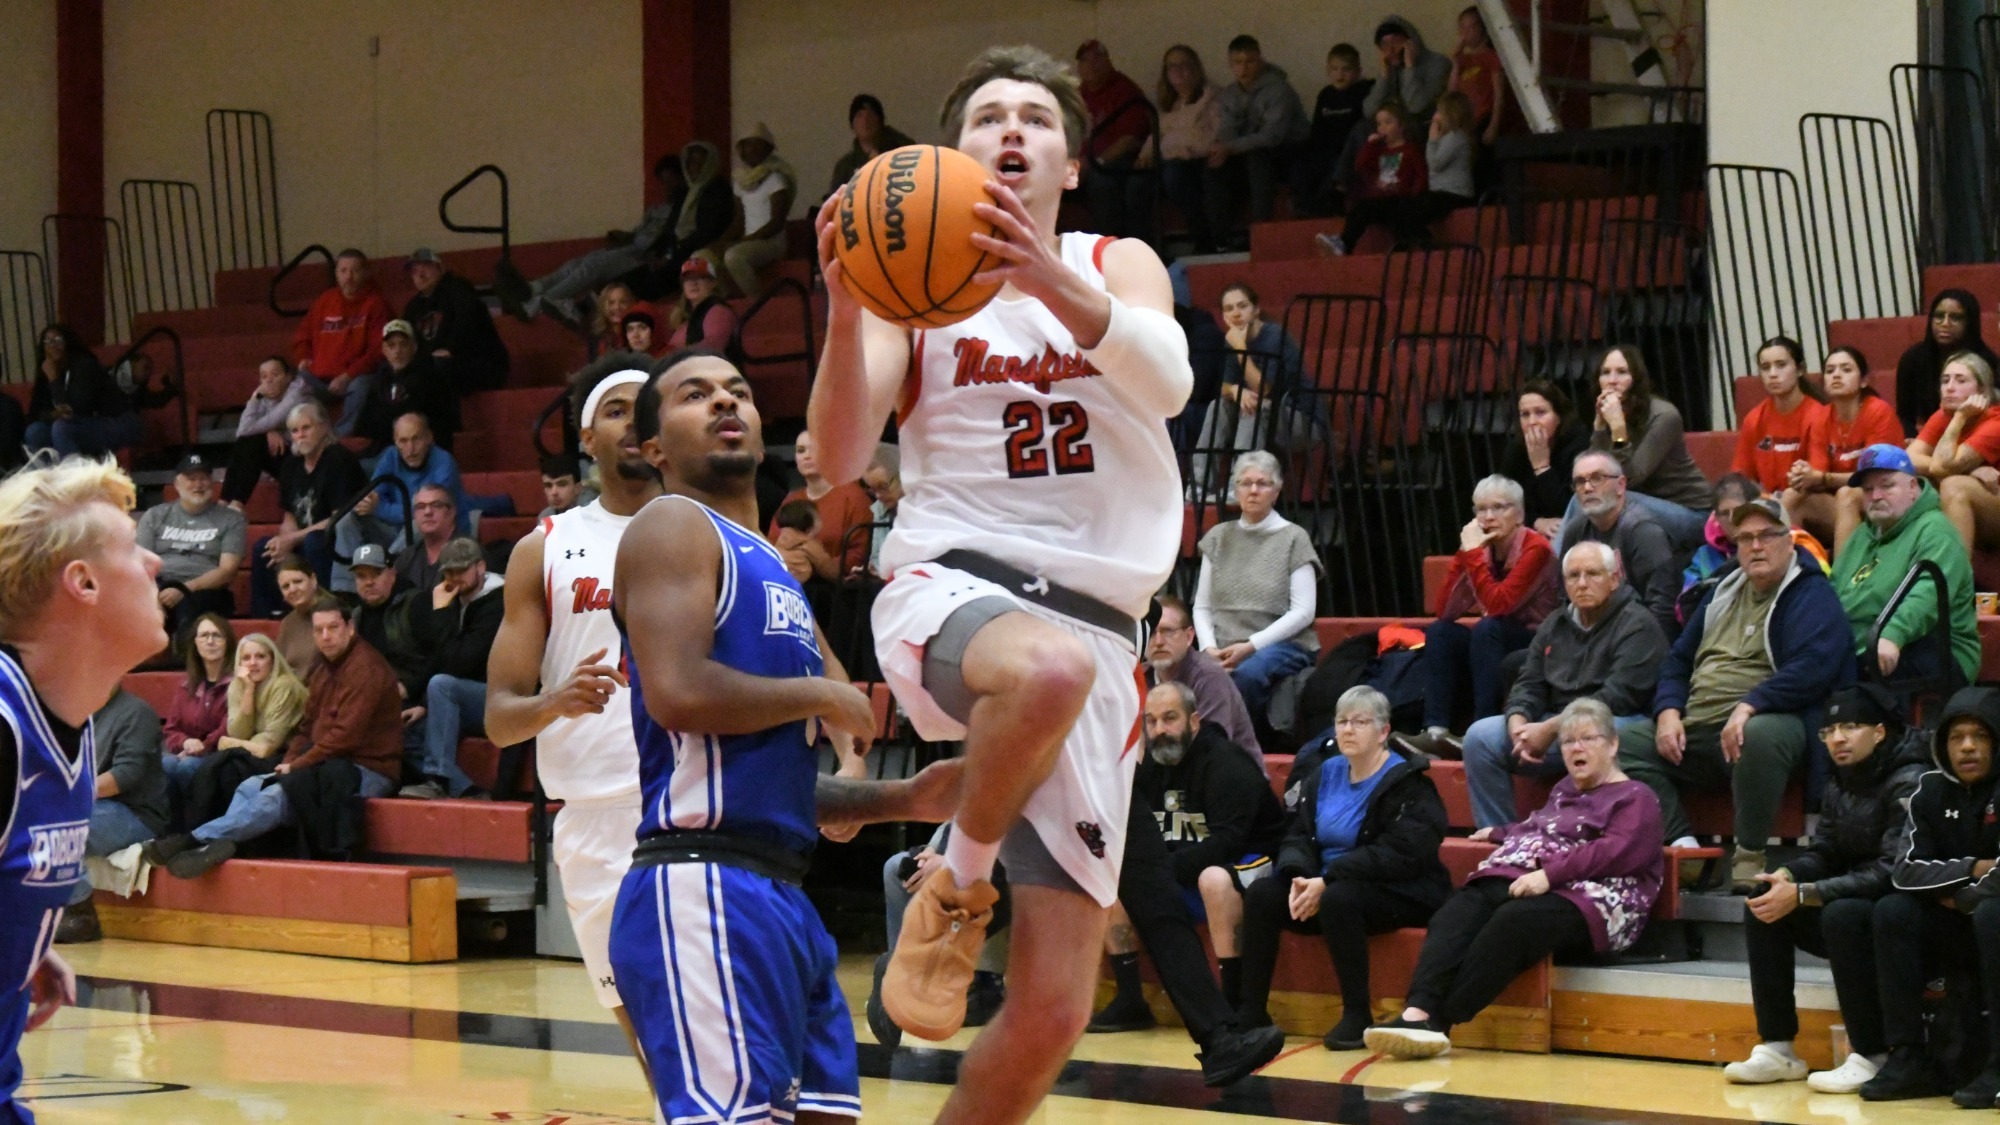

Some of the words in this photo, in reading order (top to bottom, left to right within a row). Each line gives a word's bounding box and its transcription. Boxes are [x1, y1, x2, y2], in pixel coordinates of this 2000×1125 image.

[884, 149, 923, 257] Wilson
[1003, 400, 1095, 479] 22
[161, 525, 219, 543] YANKEES
[360, 545, 371, 560] P
